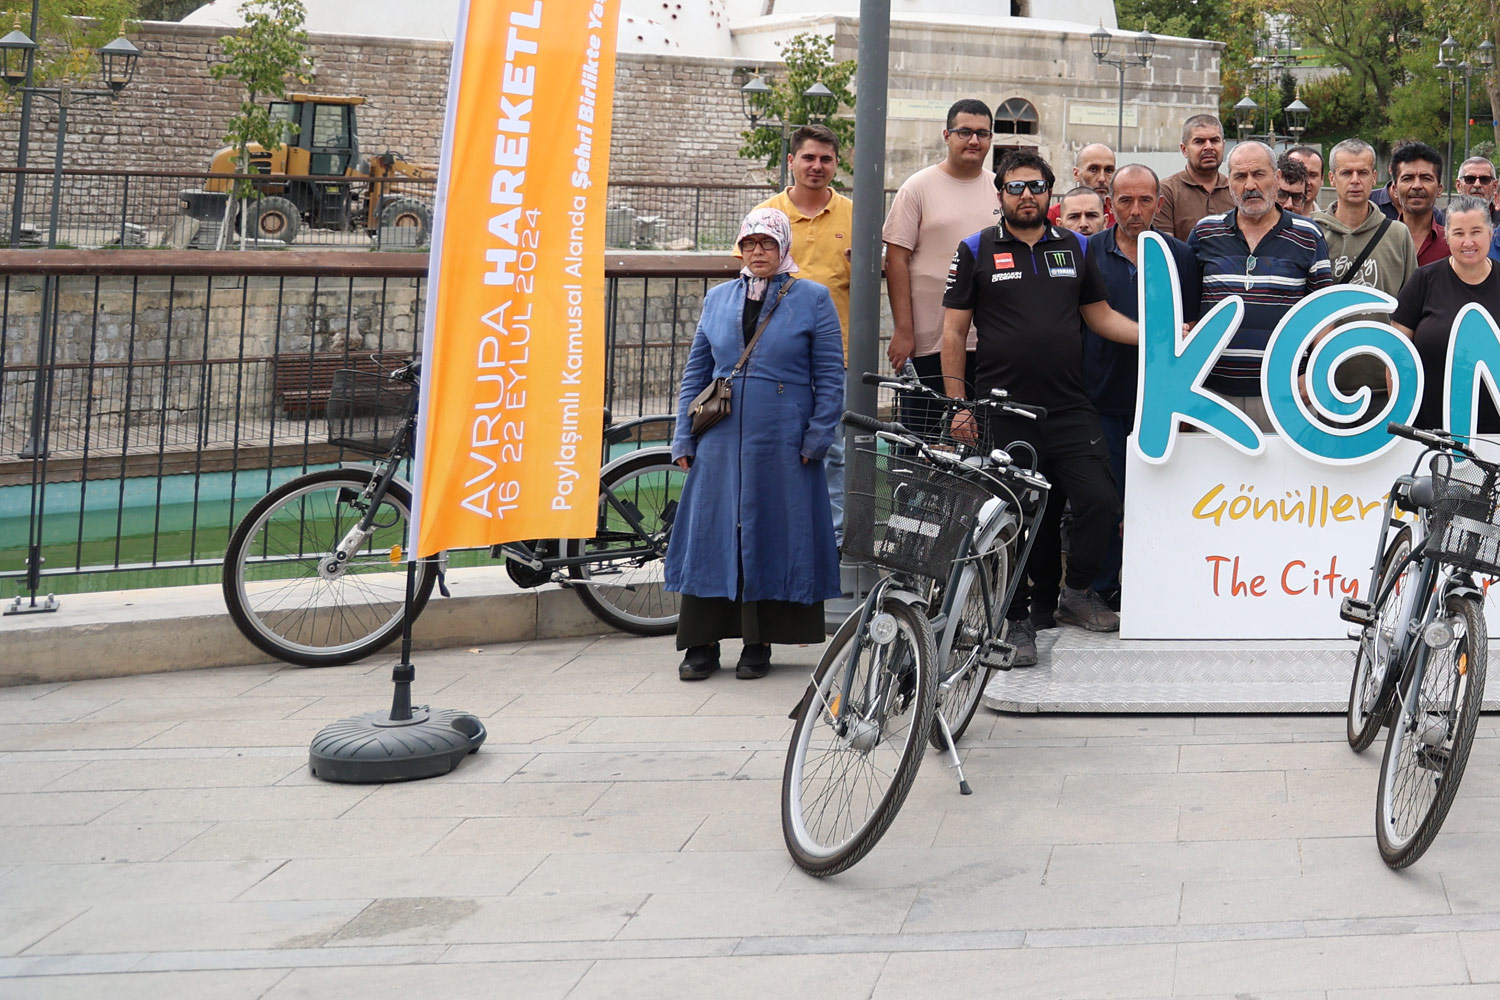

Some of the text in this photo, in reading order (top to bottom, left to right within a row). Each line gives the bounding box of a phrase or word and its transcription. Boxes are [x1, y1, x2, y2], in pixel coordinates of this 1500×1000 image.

[578, 34, 602, 123] Birlikte
[571, 124, 593, 190] Şehri
[516, 207, 542, 294] 2024
[563, 196, 588, 279] Alanda
[561, 284, 584, 384] Kamusal
[461, 299, 513, 519] AVRUPA
[501, 420, 525, 463] 22
[551, 391, 582, 511] Paylaşımlı
[496, 480, 521, 520] 16
[1205, 555, 1268, 598] The
[1280, 555, 1359, 599] City
